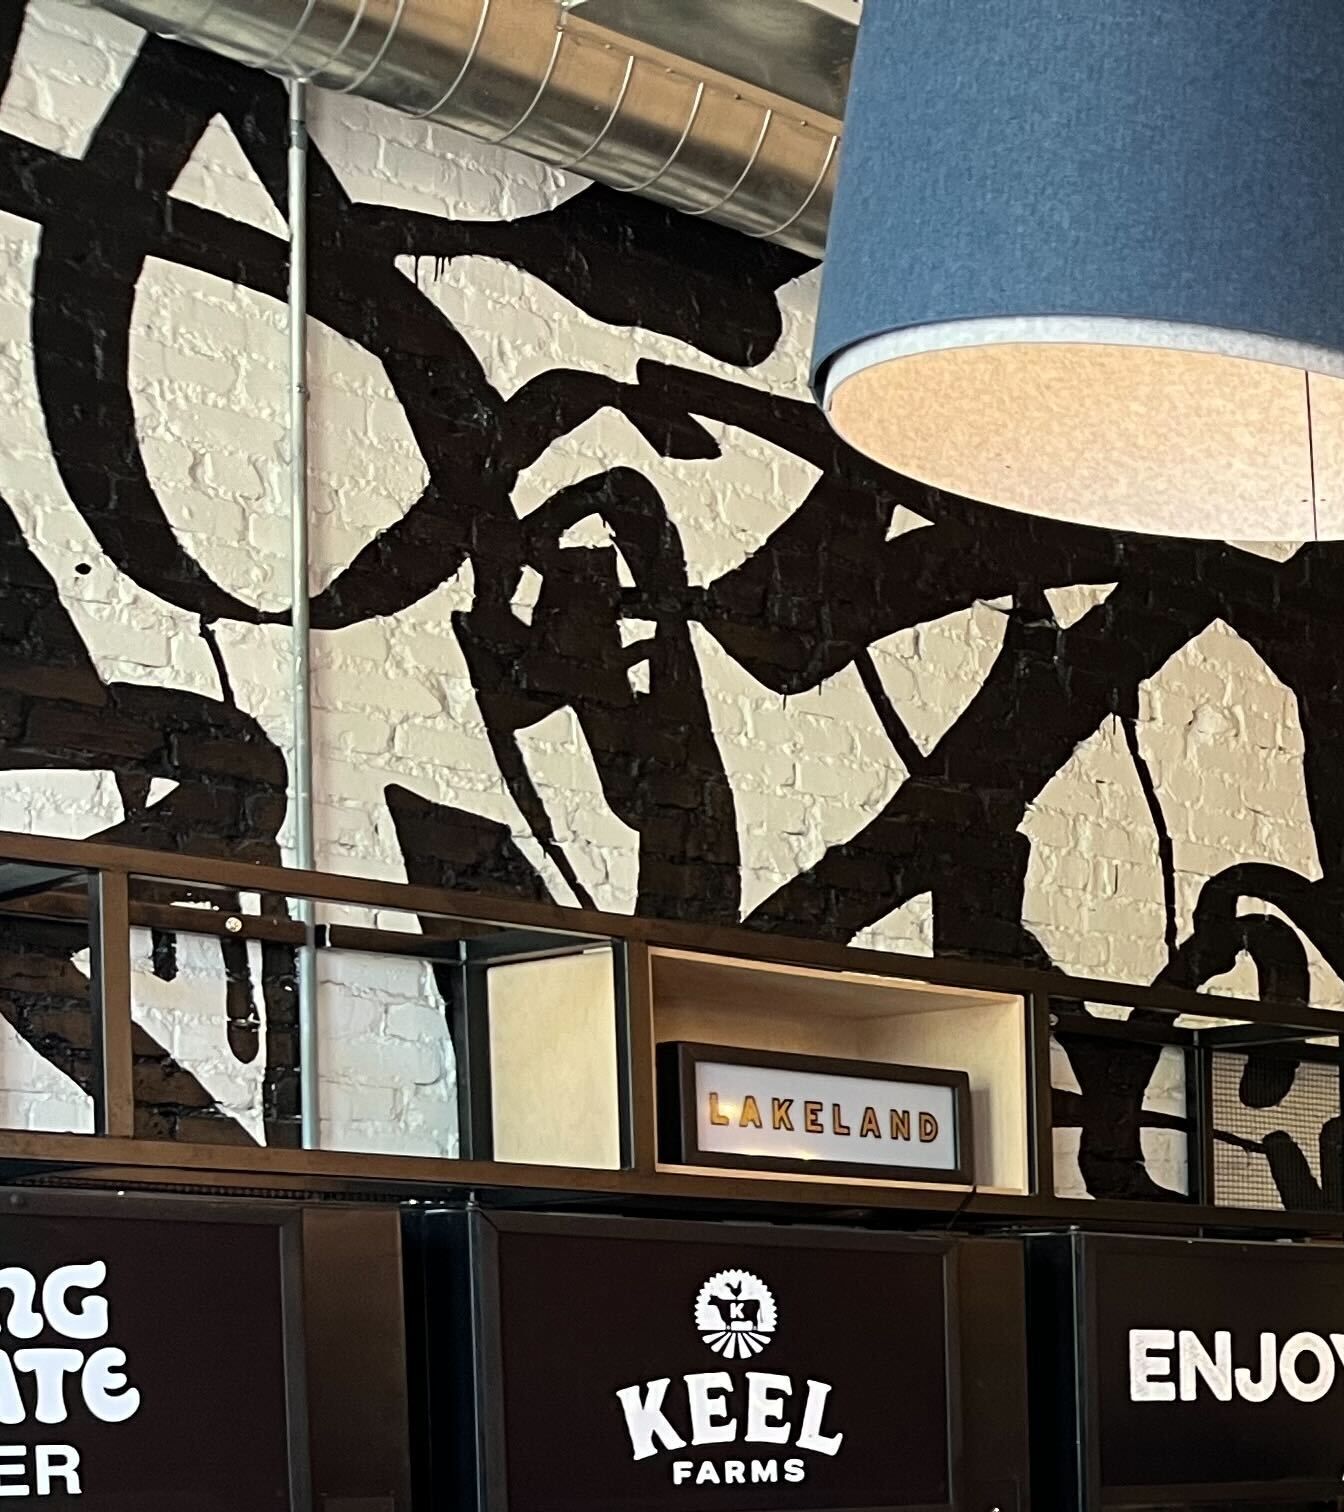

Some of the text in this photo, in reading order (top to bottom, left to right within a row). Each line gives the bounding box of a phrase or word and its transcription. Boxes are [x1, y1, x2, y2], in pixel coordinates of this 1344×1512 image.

[708, 1091, 939, 1143] LAKELAND
[730, 1302, 745, 1319] K
[615, 1371, 844, 1461] KEEL
[672, 1458, 805, 1485] FARMS
